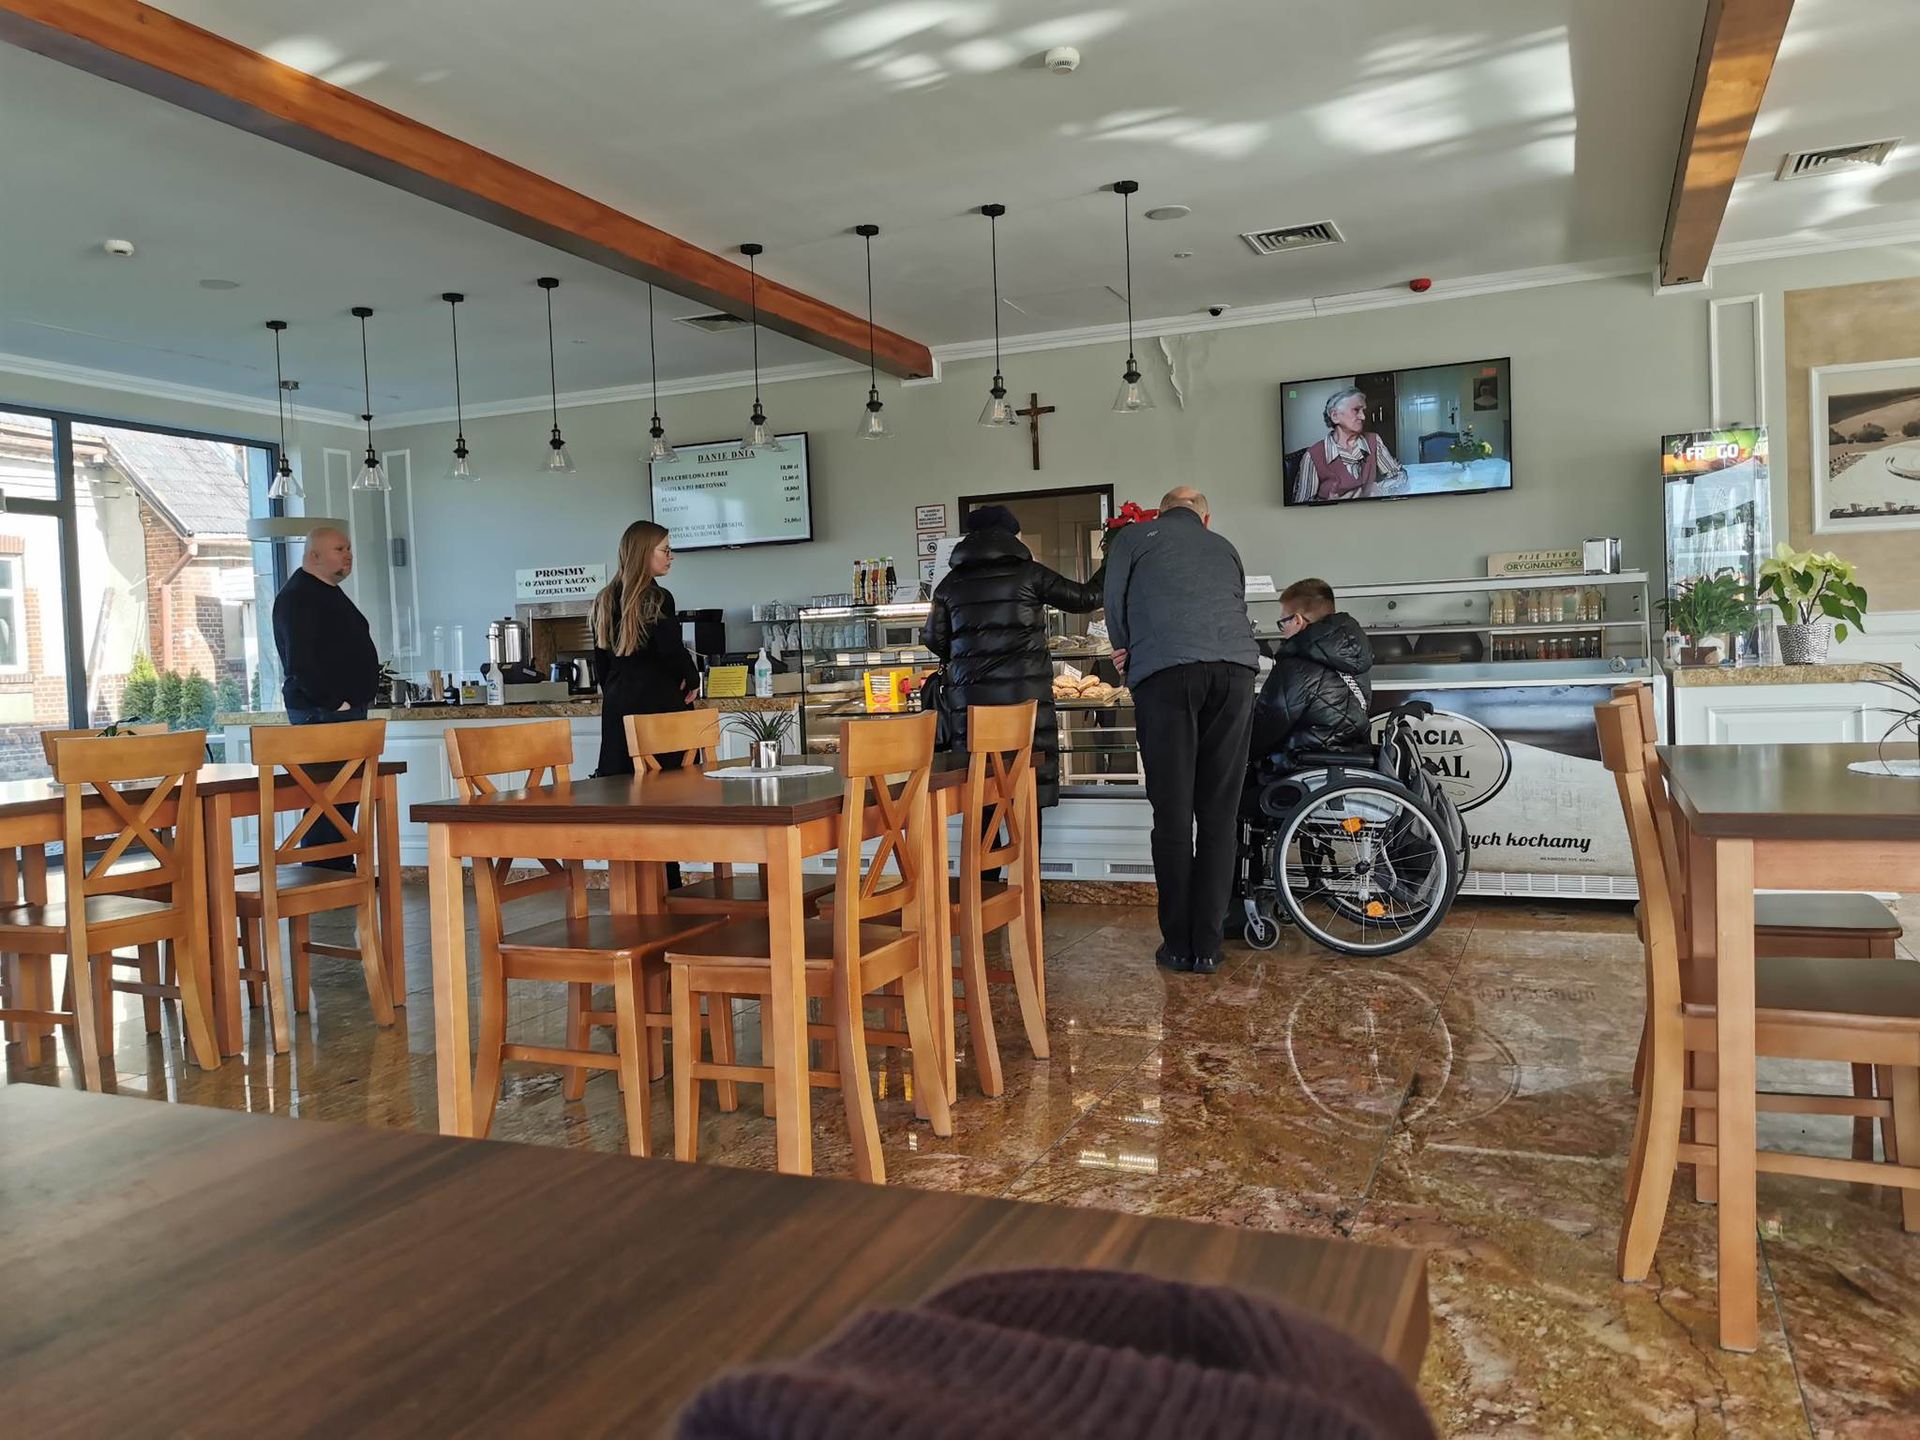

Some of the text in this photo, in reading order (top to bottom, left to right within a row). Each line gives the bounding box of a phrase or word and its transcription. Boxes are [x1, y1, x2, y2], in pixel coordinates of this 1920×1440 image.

[697, 449, 756, 462] DANIE DNIA
[1506, 560, 1563, 571] ORYGINALNY
[535, 567, 586, 578] PROSIMY
[533, 579, 562, 587] ZWROT
[564, 575, 597, 584] NACZYŃ
[535, 586, 588, 596] DZIĘKUJEMY
[1506, 832, 1591, 853] kochamy
